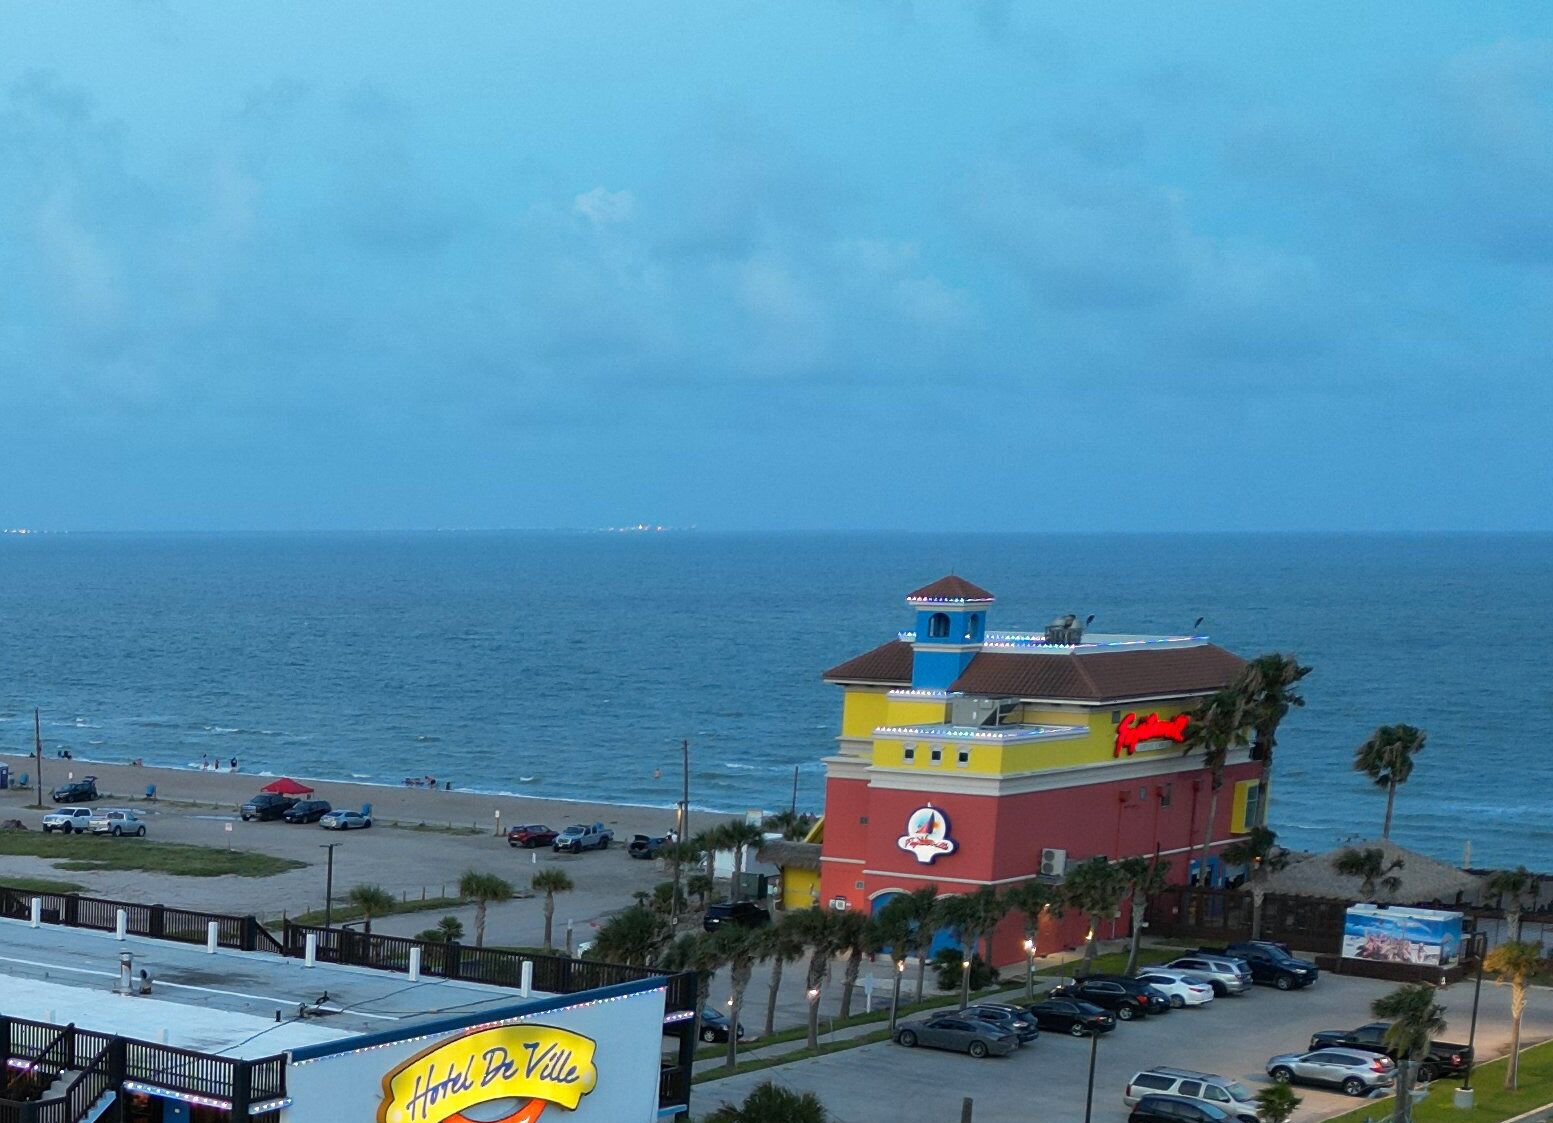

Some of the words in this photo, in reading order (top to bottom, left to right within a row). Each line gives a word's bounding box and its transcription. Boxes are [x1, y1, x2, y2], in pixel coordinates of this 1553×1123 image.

[406, 1054, 475, 1121] Hotel
[481, 1047, 519, 1088] De
[524, 1042, 580, 1084] Ville
